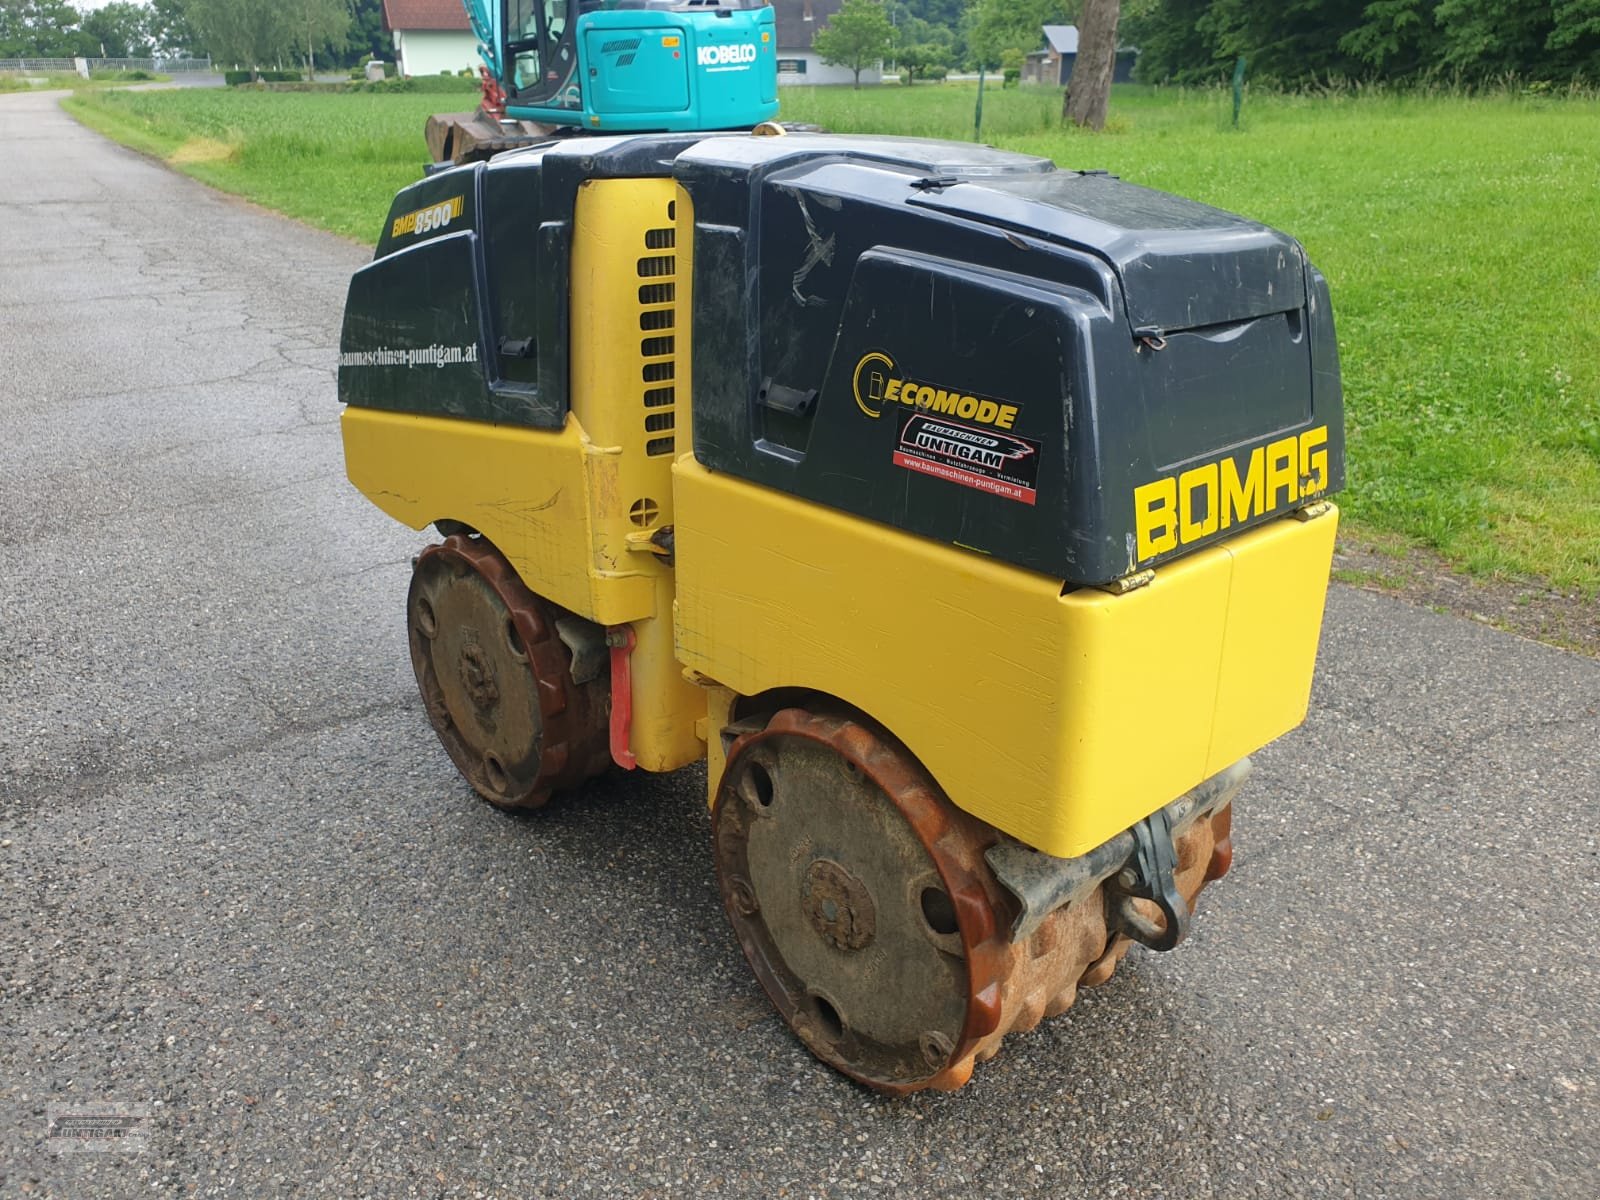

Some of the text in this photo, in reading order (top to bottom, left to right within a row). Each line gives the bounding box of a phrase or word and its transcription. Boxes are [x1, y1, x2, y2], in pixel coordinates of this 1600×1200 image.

[697, 44, 756, 65] KOBELCO
[414, 203, 452, 235] 8500
[884, 378, 1018, 429] ECOMODE
[903, 458, 1022, 498] www.baumaschinen-puntigam.at
[1134, 425, 1328, 562] BOMAG
